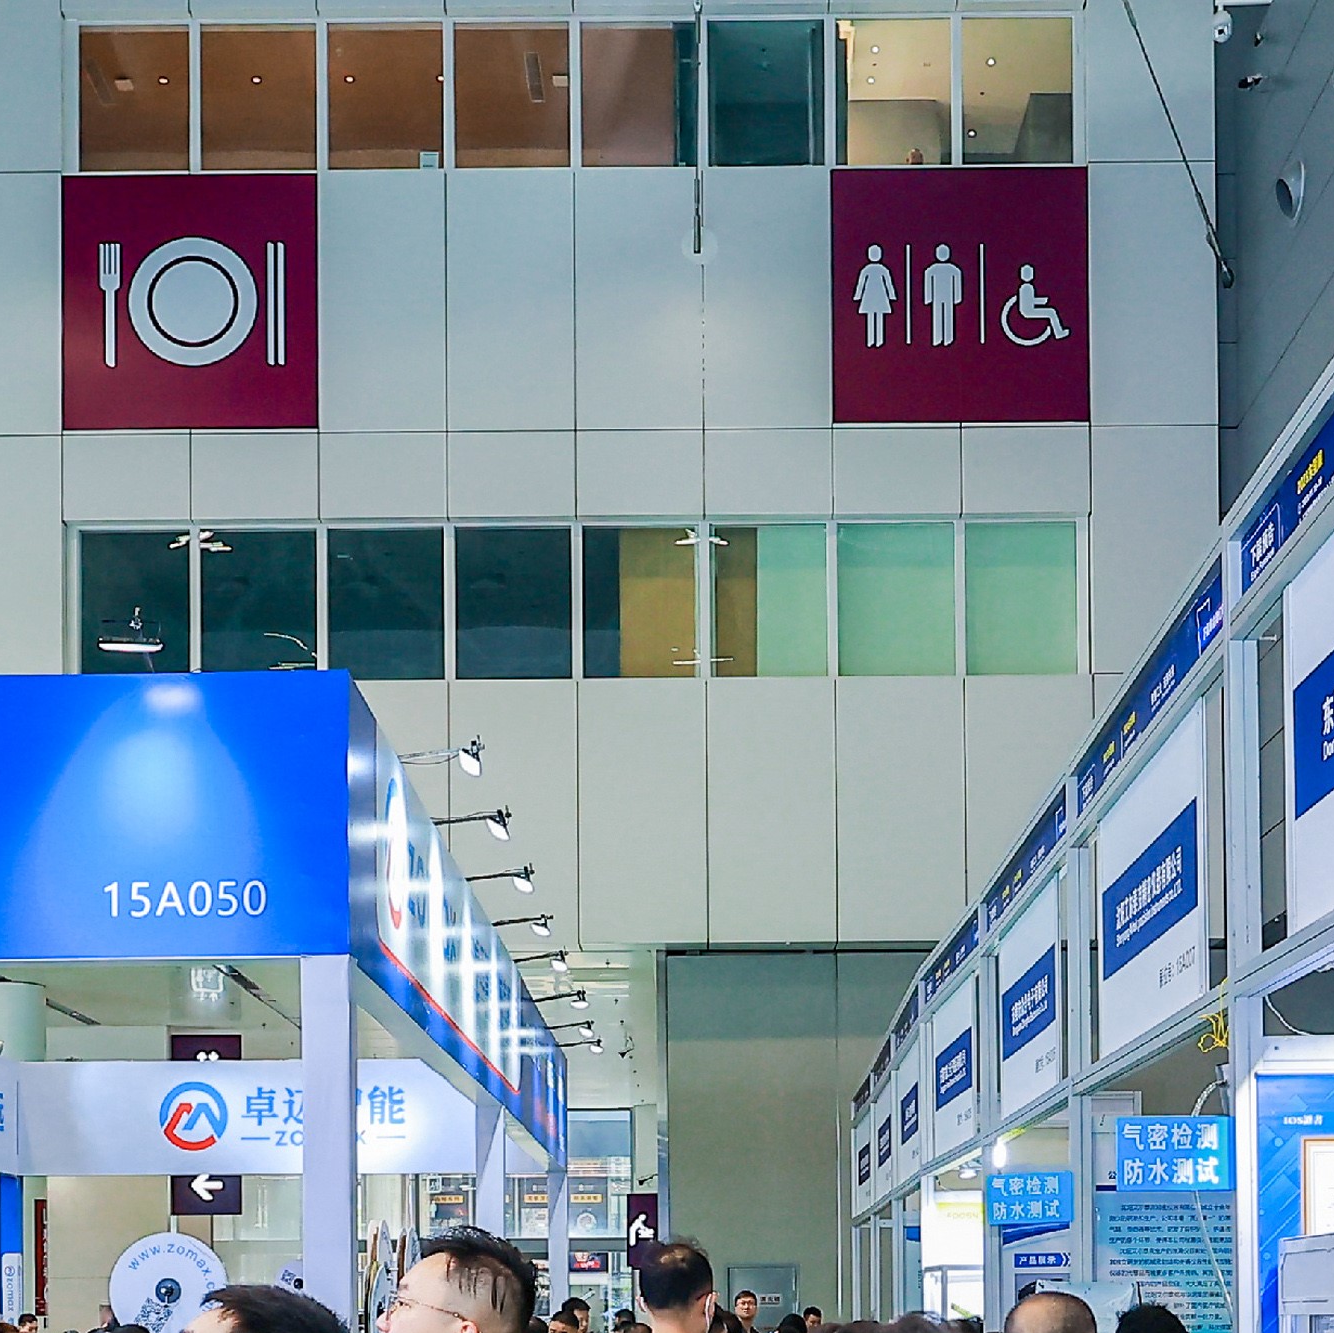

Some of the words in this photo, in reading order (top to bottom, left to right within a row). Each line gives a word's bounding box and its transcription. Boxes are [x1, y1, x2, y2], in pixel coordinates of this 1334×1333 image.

[104, 880, 269, 920] 15A050
[241, 1085, 406, 1127] 卓迈能
[275, 1130, 366, 1147] zox
[1122, 1122, 1219, 1151] 气密检测
[1123, 1156, 1219, 1186] 防水测试
[991, 1175, 1060, 1197] 气密检测
[992, 1199, 1060, 1219] 防水测试
[128, 1243, 215, 1292] www.zomax.c
